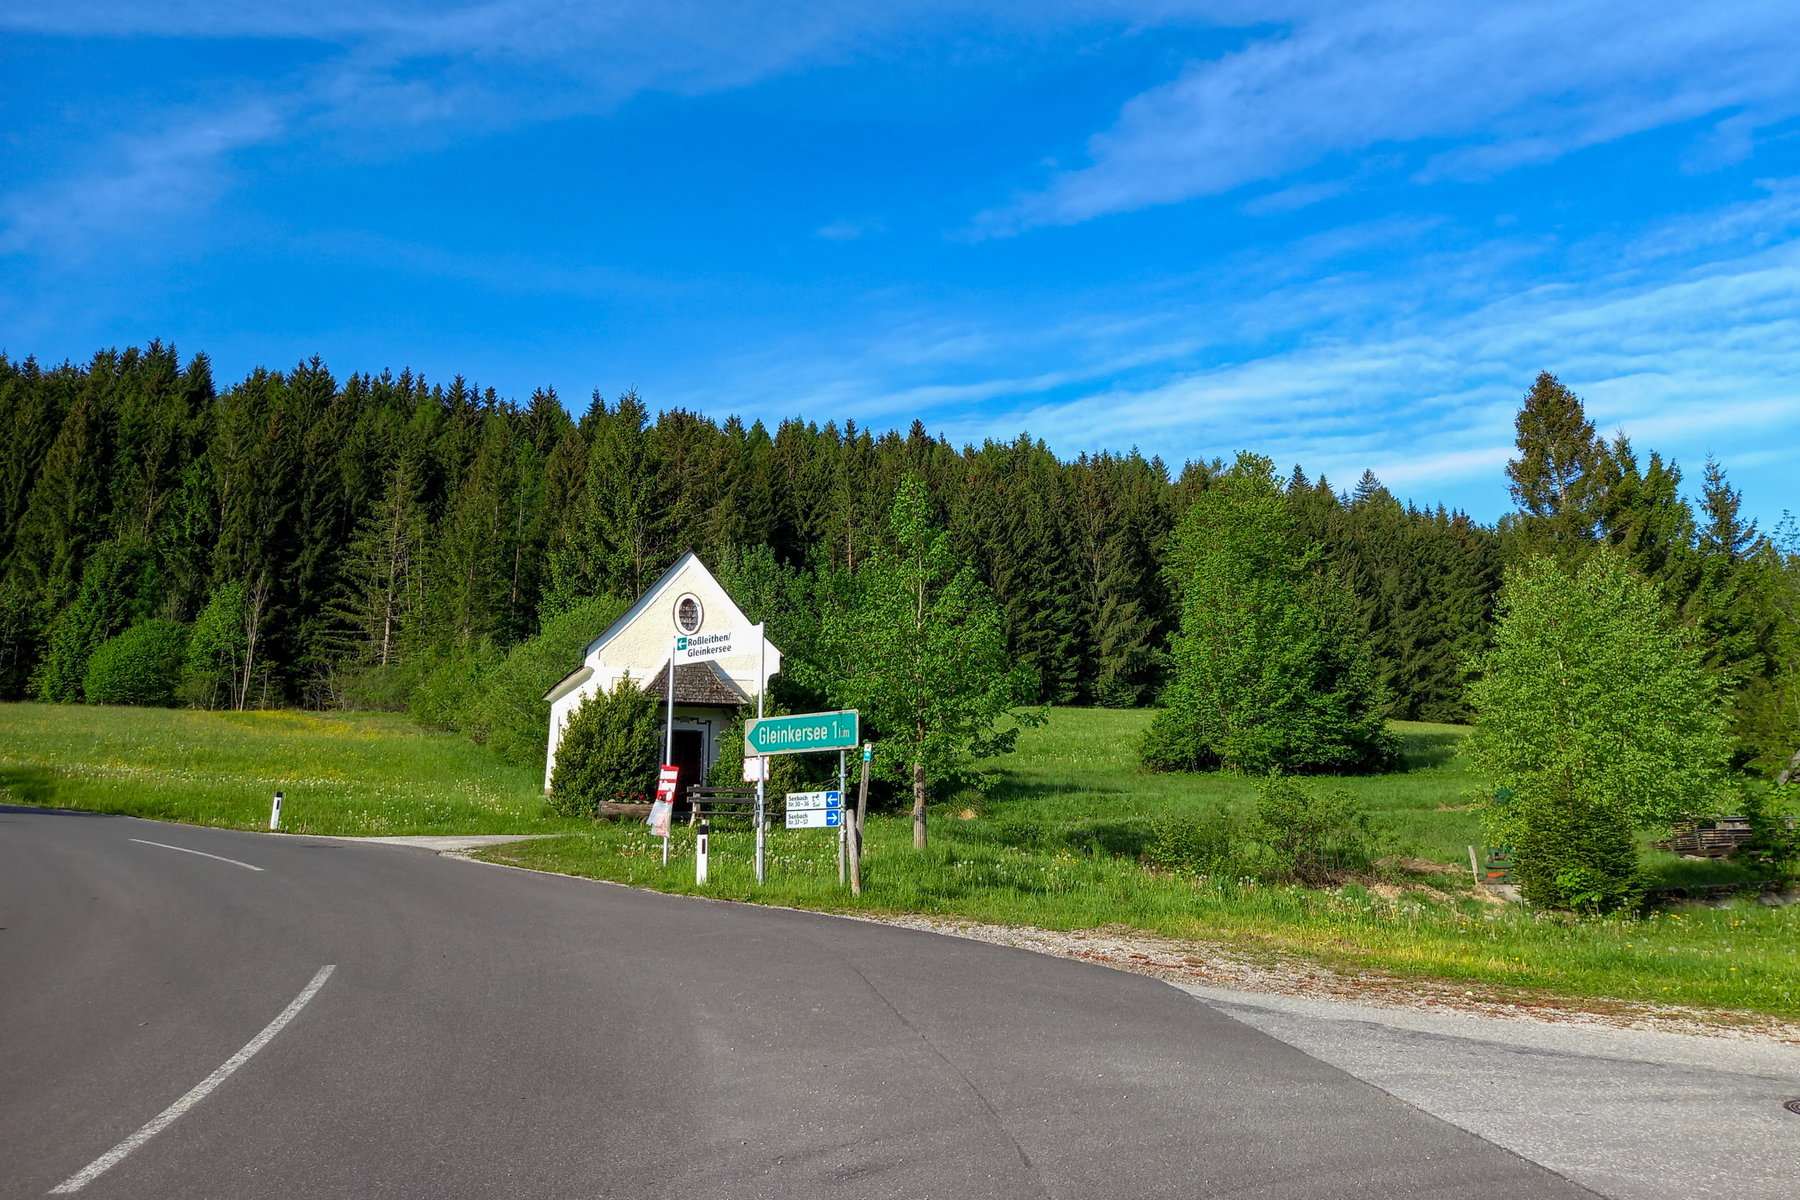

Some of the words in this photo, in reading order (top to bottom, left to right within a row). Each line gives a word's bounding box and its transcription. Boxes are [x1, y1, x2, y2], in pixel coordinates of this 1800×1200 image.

[688, 632, 731, 647] Roßleithen/
[688, 644, 732, 657] Gleinkersee
[759, 724, 828, 745] Gleinkersee
